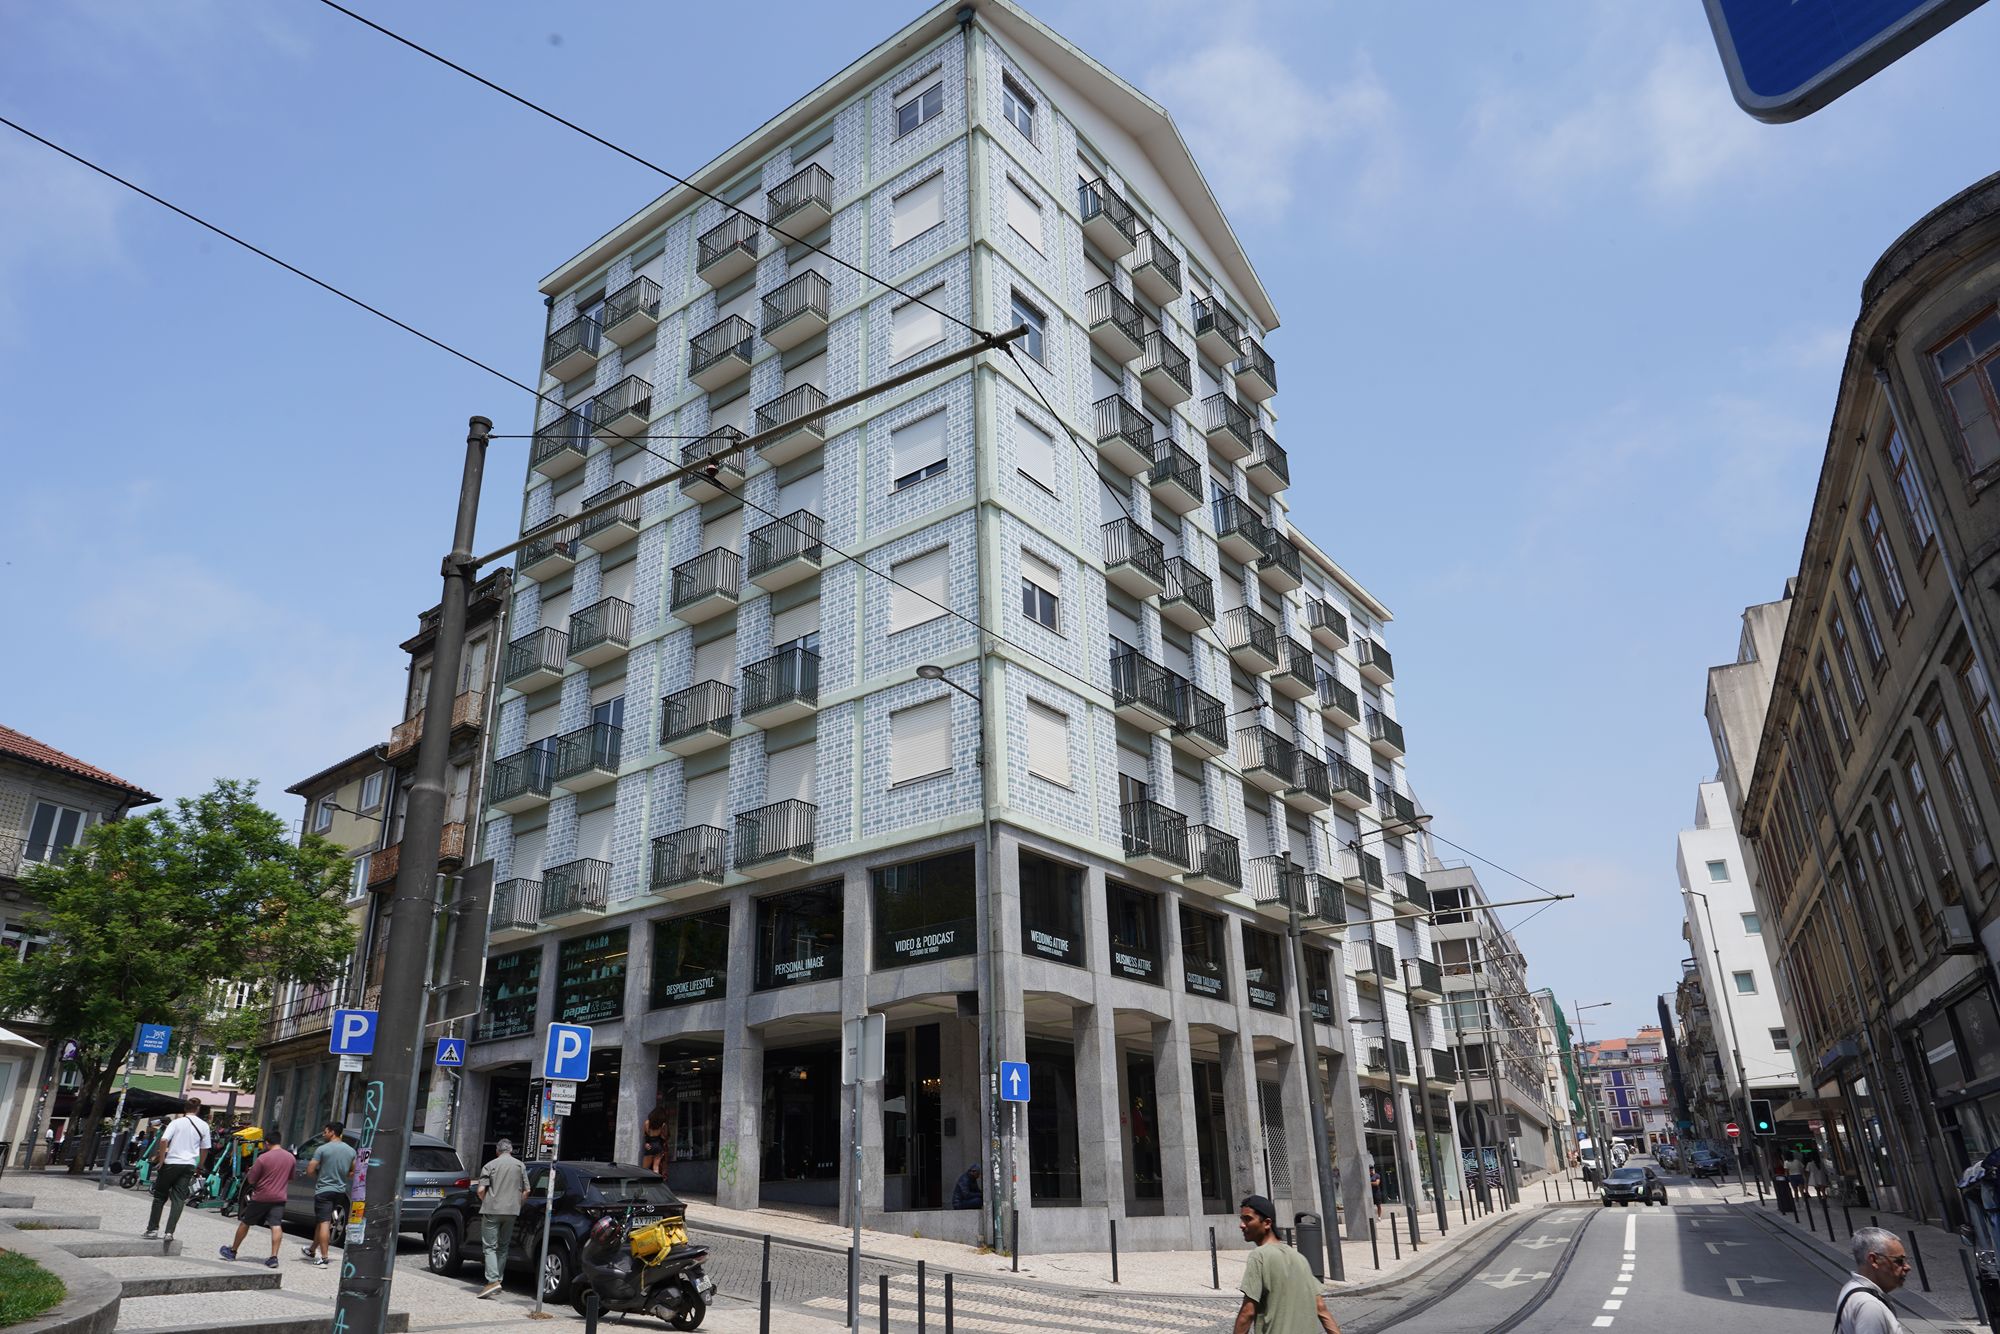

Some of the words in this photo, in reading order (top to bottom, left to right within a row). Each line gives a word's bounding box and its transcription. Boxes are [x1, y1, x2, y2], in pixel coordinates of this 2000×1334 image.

[895, 937, 914, 952] VIDEO
[916, 938, 922, 949] &
[923, 930, 955, 947] PODCAST
[1030, 930, 1053, 947] WEDDING
[1053, 937, 1069, 951] ATTIRE
[775, 961, 804, 976] PERSONAL
[805, 955, 824, 970] IMAGE
[1115, 952, 1138, 968] BUSINESS
[1138, 958, 1152, 972] ATTIRE
[666, 980, 690, 996] BESPOKE
[690, 976, 714, 992] LIFESTYLE
[1249, 986, 1264, 999] CUSTOM
[562, 1002, 591, 1020] papel
[340, 1014, 369, 1049] P
[554, 1029, 582, 1074] P
[525, 1125, 533, 1158] Portuguese
